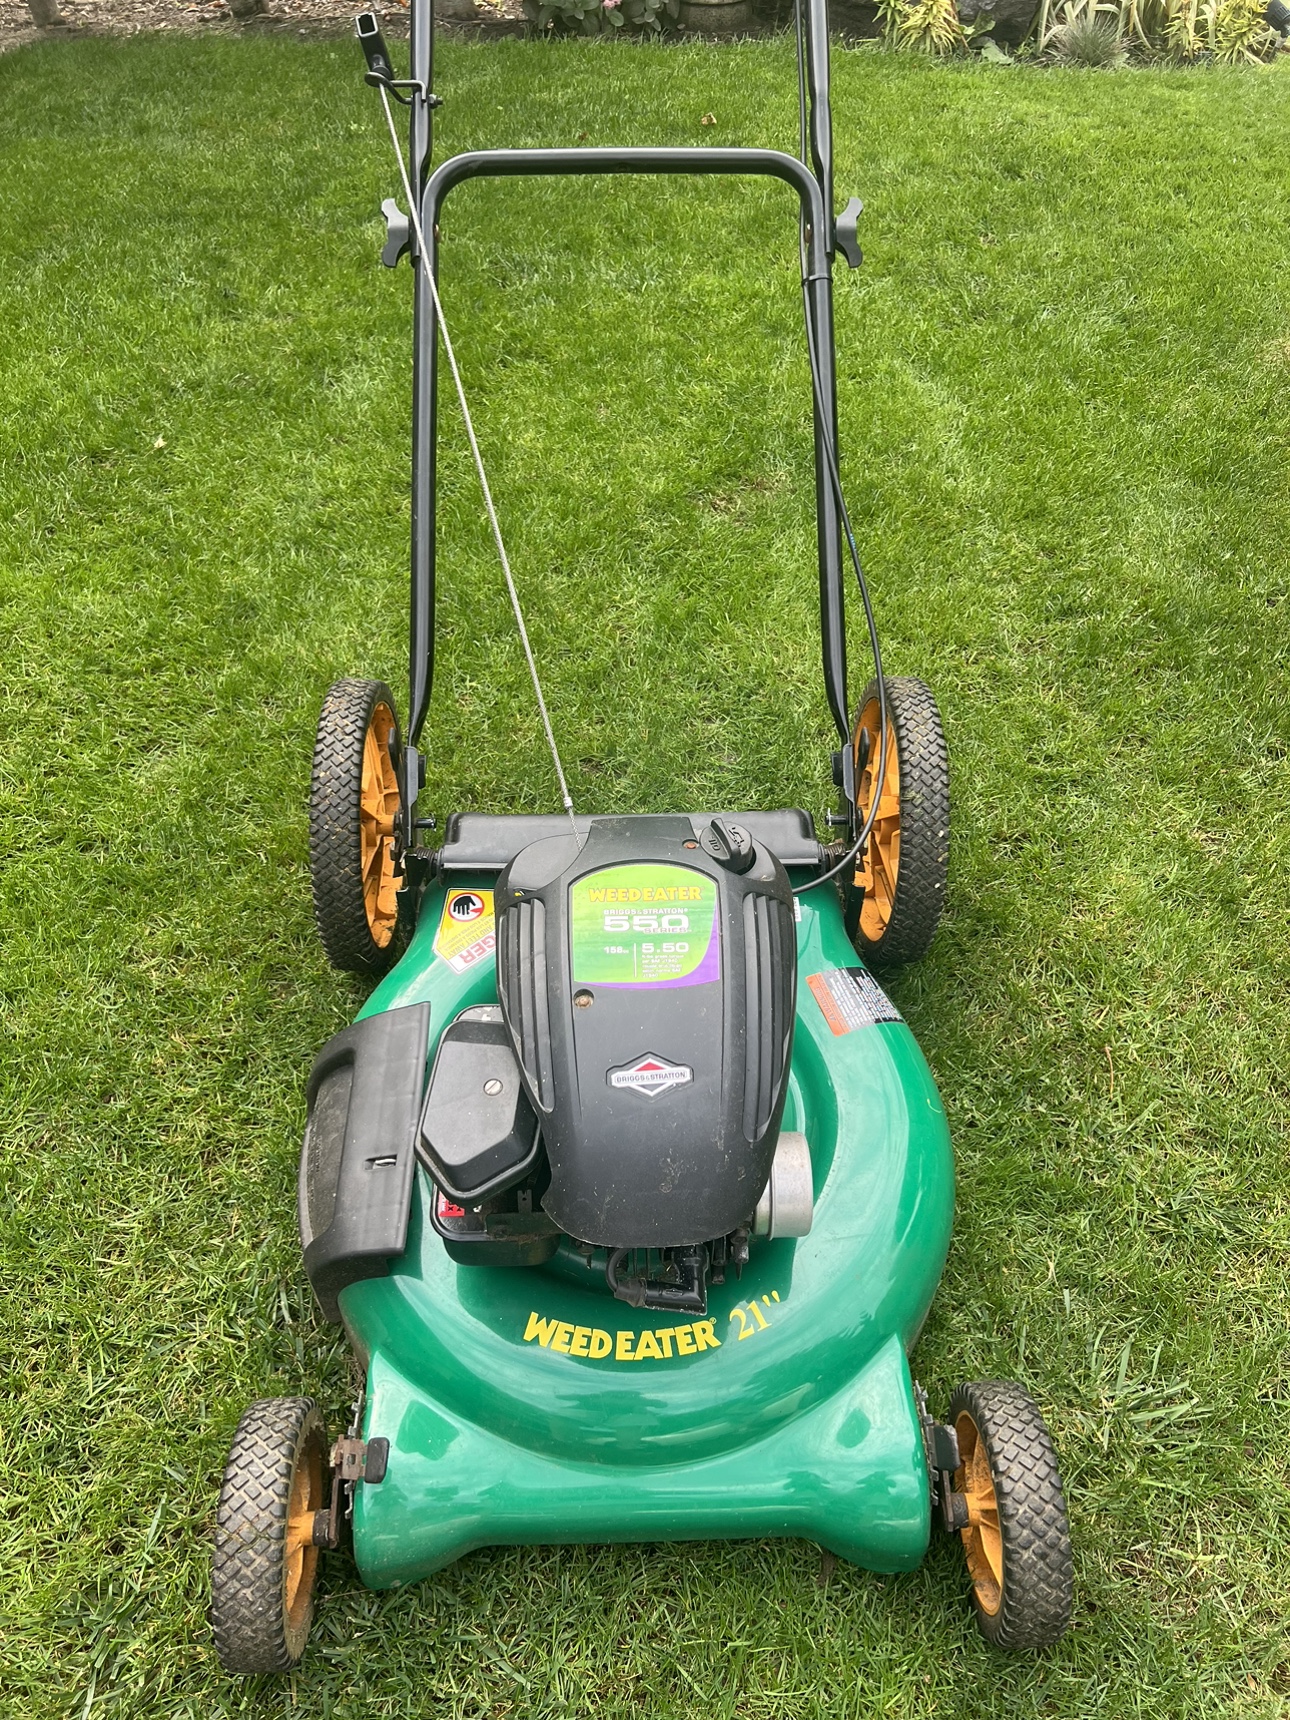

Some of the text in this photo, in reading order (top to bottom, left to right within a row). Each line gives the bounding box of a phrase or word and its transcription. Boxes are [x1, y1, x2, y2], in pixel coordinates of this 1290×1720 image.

[603, 915, 688, 931] 550
[459, 935, 496, 963] GER
[641, 942, 689, 953] 5.50
